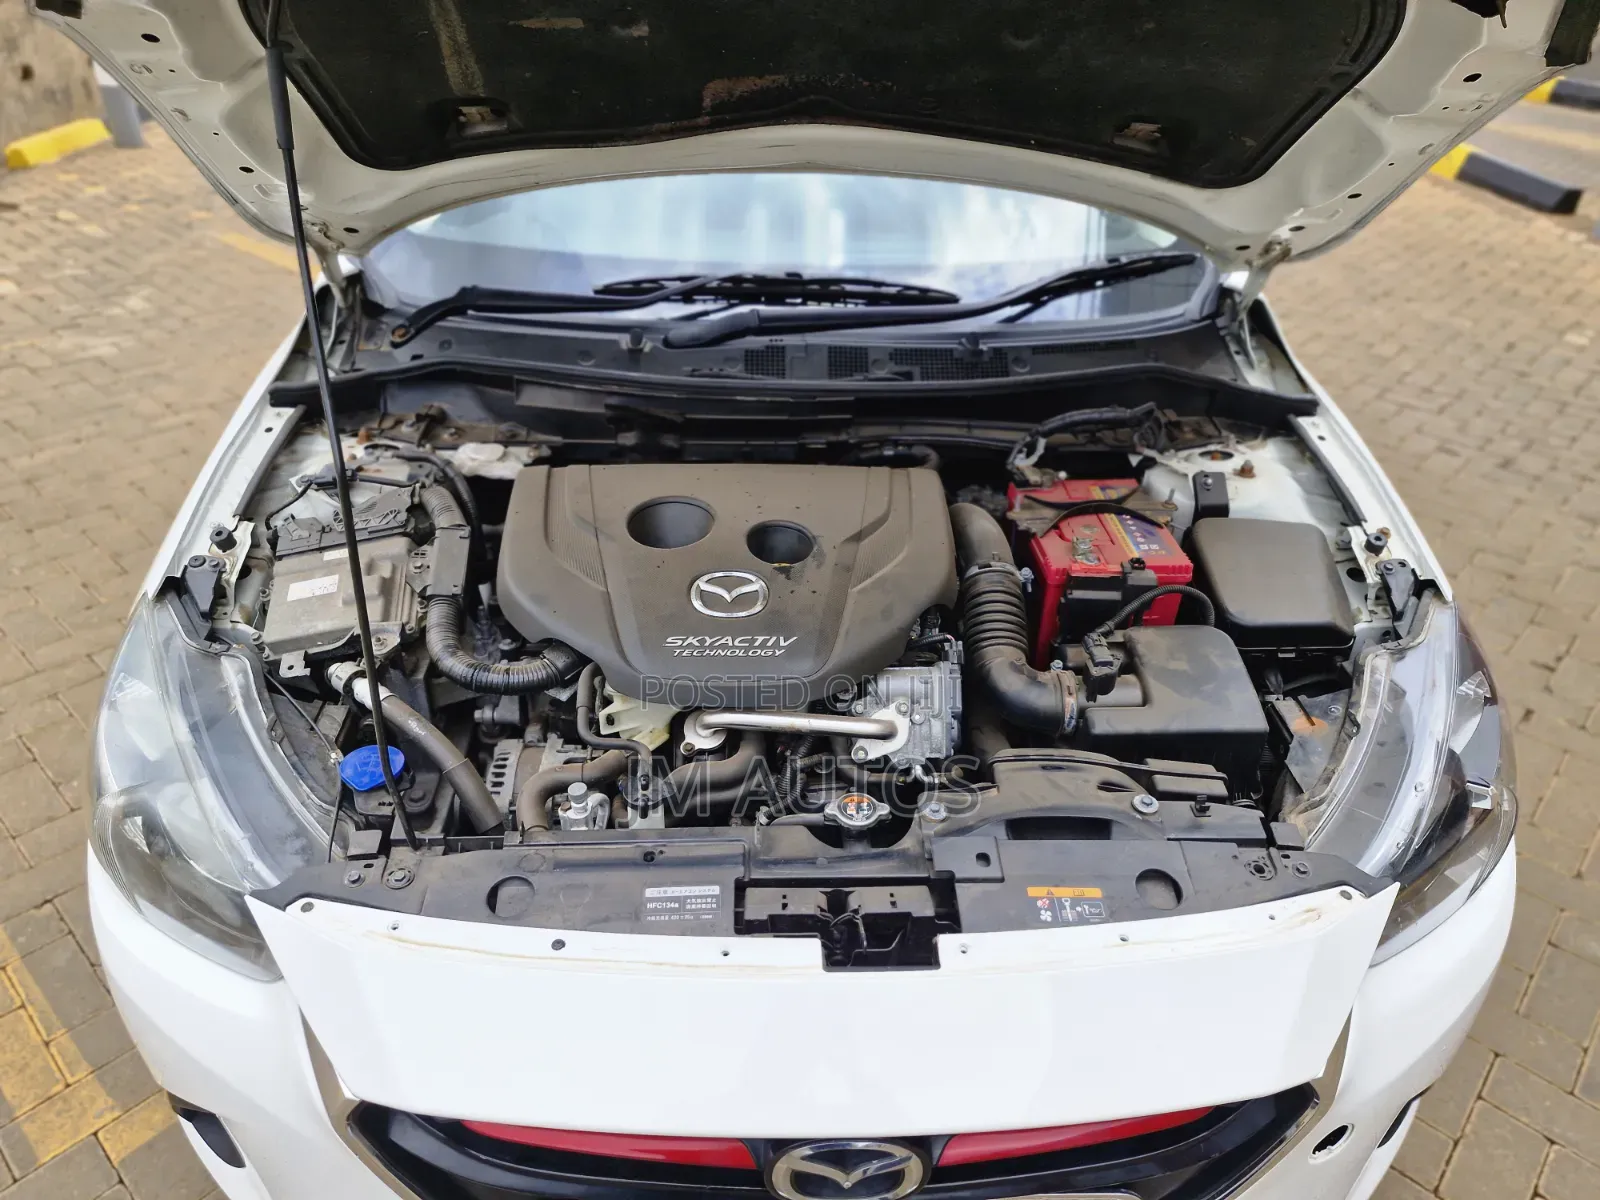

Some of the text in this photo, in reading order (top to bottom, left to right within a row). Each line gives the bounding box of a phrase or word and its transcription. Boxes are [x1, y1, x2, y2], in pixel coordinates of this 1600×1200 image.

[663, 635, 798, 648] SKYACTIV
[672, 648, 786, 658] TECHNOLOGY
[646, 901, 680, 909] HFC134a
